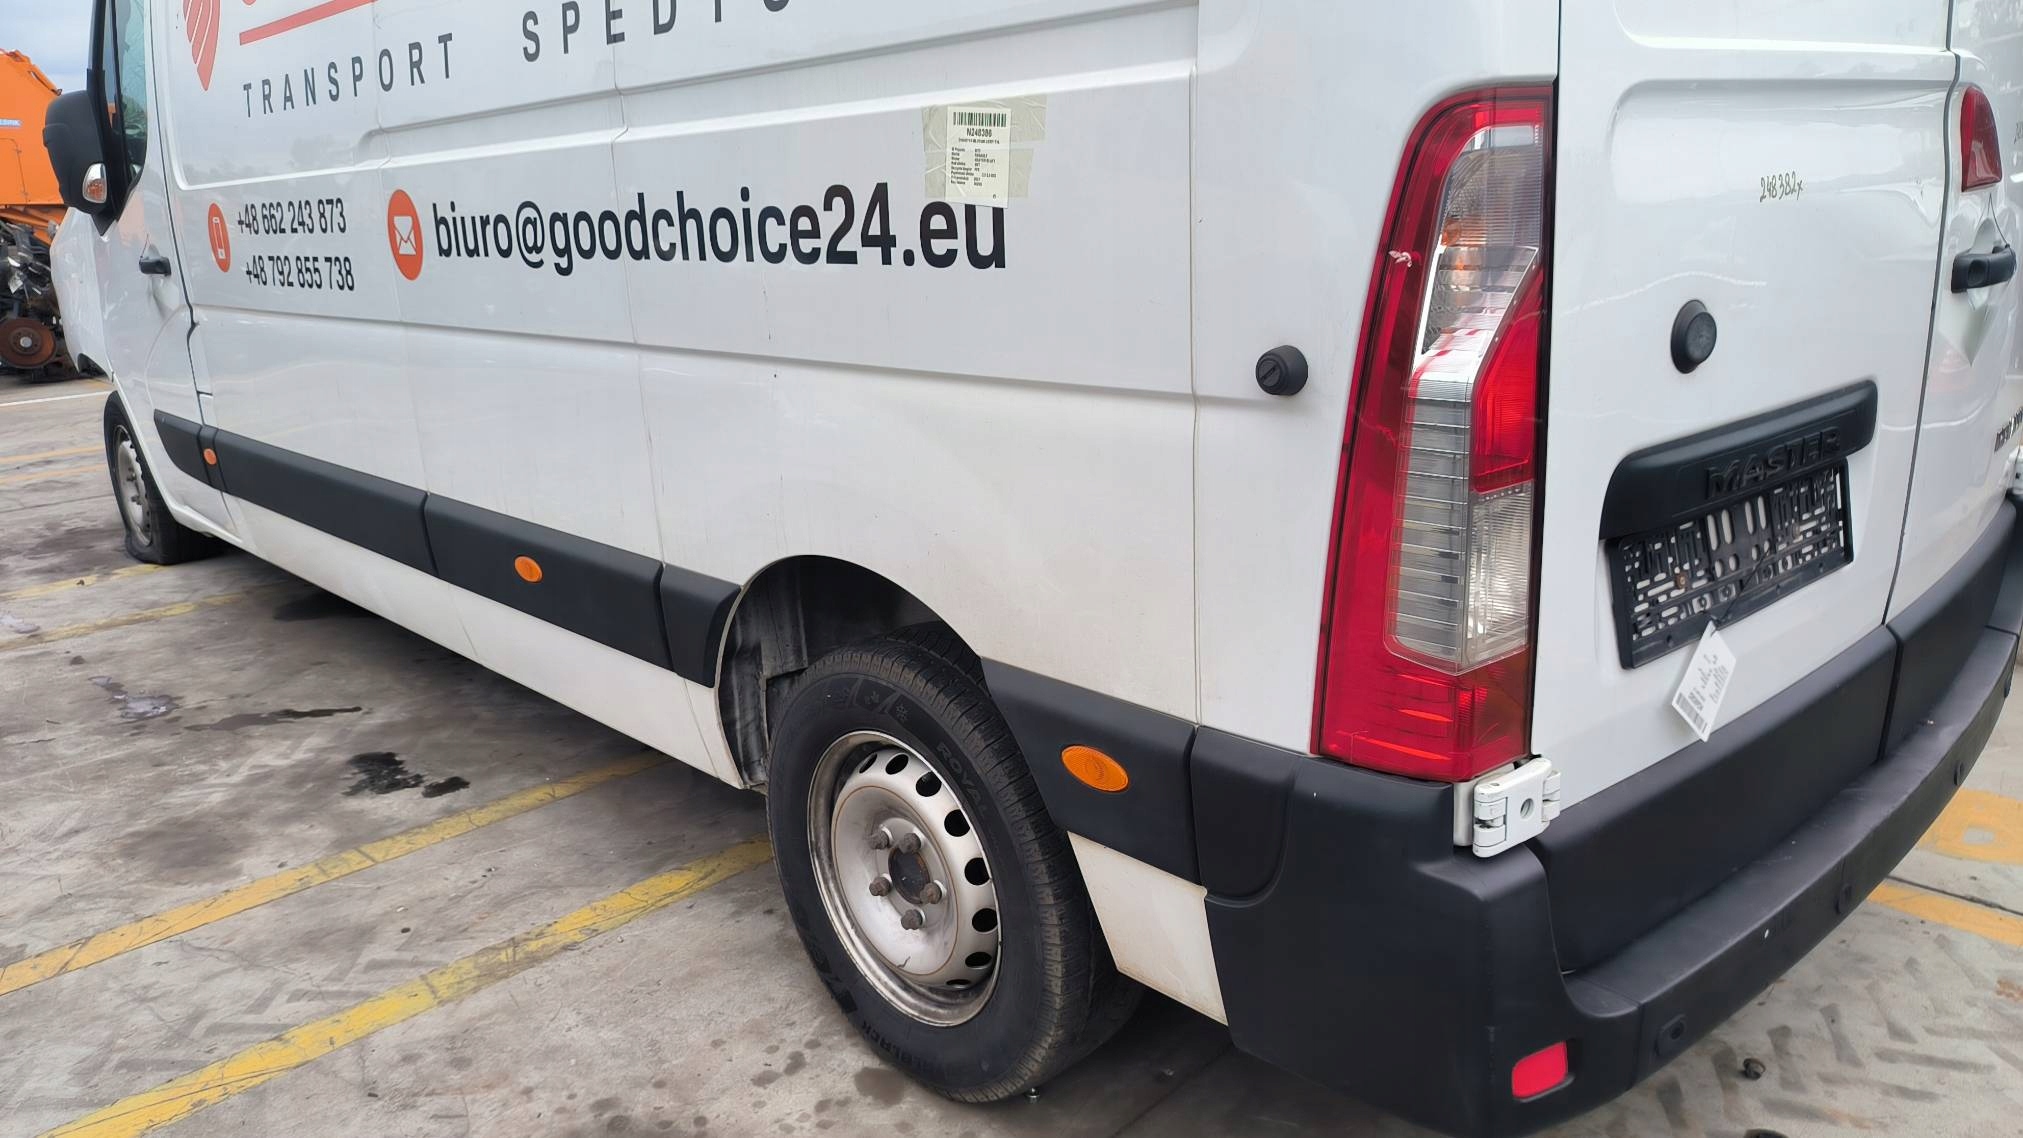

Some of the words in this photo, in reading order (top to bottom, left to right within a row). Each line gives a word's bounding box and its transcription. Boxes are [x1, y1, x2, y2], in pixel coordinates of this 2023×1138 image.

[242, 32, 453, 118] TRANSPORT
[521, 0, 790, 62] SPED
[238, 203, 260, 235] +48
[261, 202, 287, 235] 662
[288, 200, 315, 234] 243
[317, 198, 347, 234] 873
[432, 181, 1006, 277] biuro@goodchoice24.eu
[246, 255, 267, 286] +48
[268, 255, 294, 287] 792
[295, 255, 323, 289] 855
[324, 256, 355, 291] 738
[1706, 426, 1840, 498] MASTER
[935, 740, 986, 818] ROYAL
